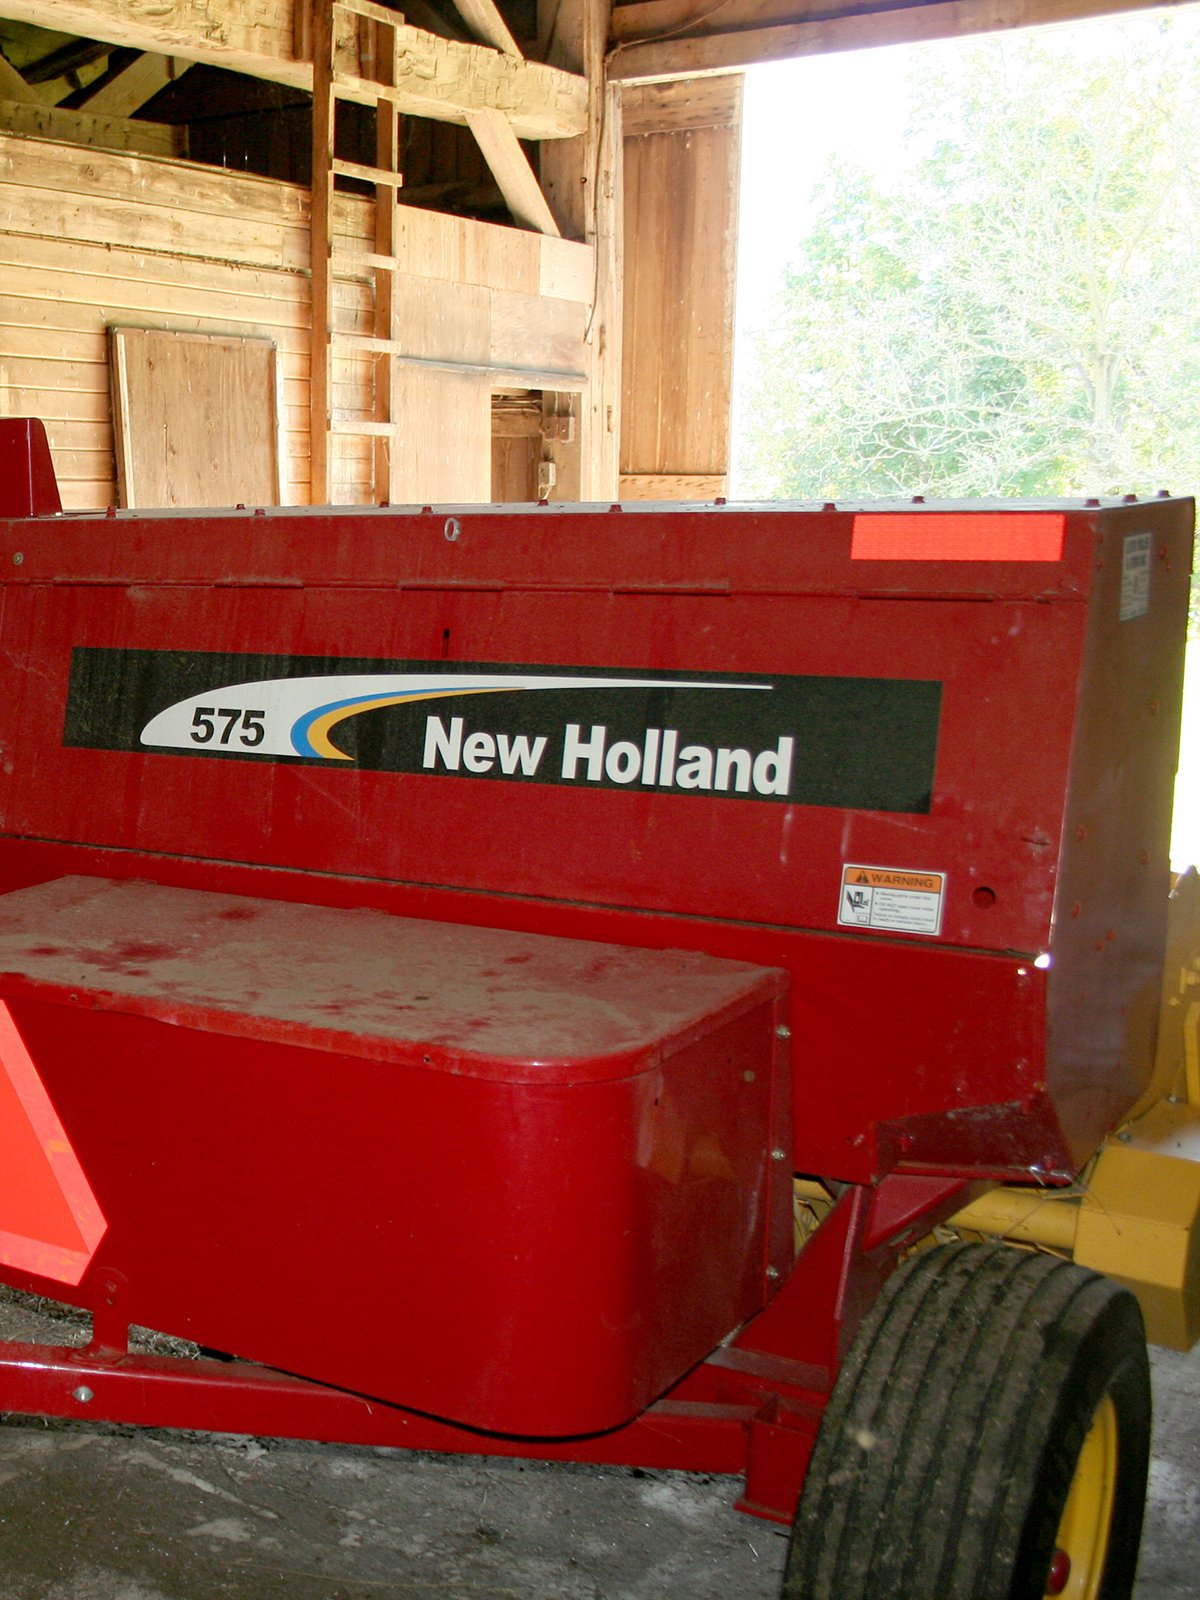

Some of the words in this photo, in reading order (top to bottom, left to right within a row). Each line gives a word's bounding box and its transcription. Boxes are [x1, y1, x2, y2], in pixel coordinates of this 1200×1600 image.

[190, 707, 266, 748] 575
[422, 715, 547, 777] New
[561, 723, 795, 797] Holland
[871, 873, 934, 889] WARNING
